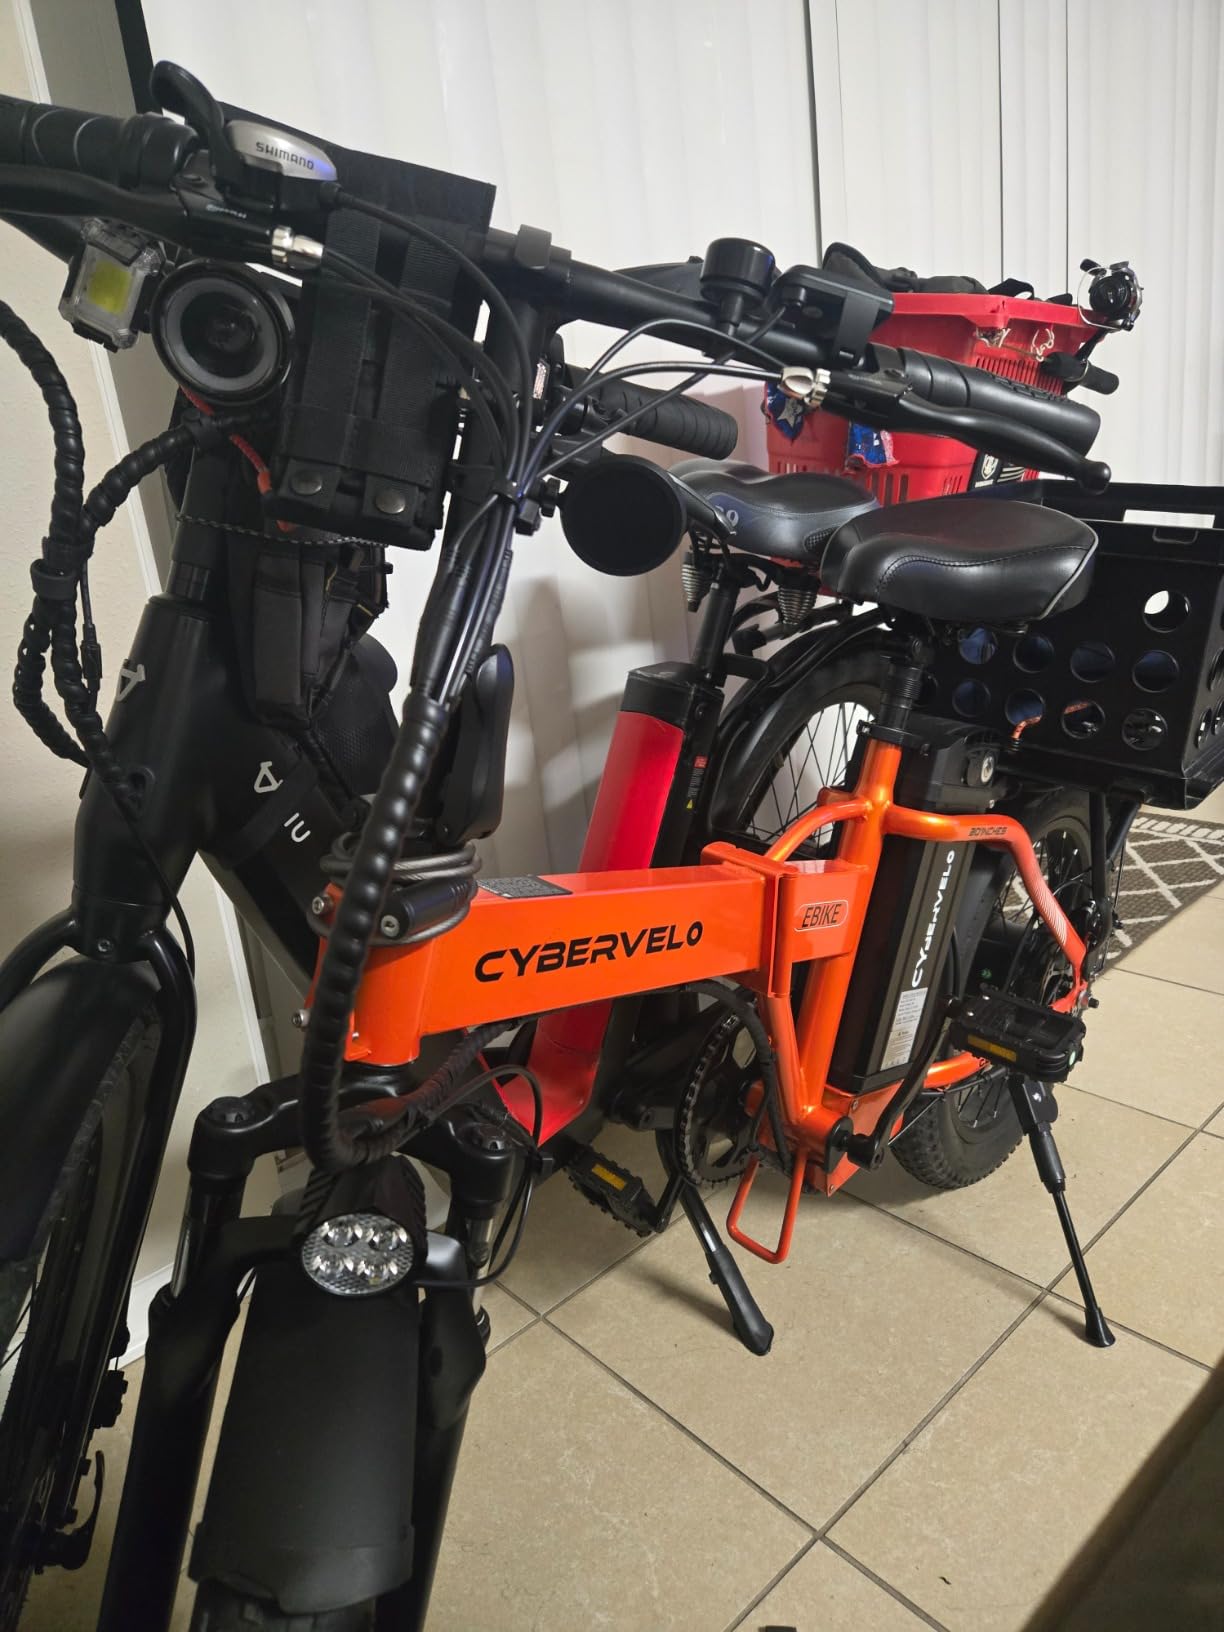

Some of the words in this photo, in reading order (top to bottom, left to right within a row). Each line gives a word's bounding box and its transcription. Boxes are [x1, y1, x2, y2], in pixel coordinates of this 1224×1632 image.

[256, 142, 315, 171] SHIMANO
[802, 903, 842, 928] EBIKE
[474, 921, 704, 983] CYBERVELO
